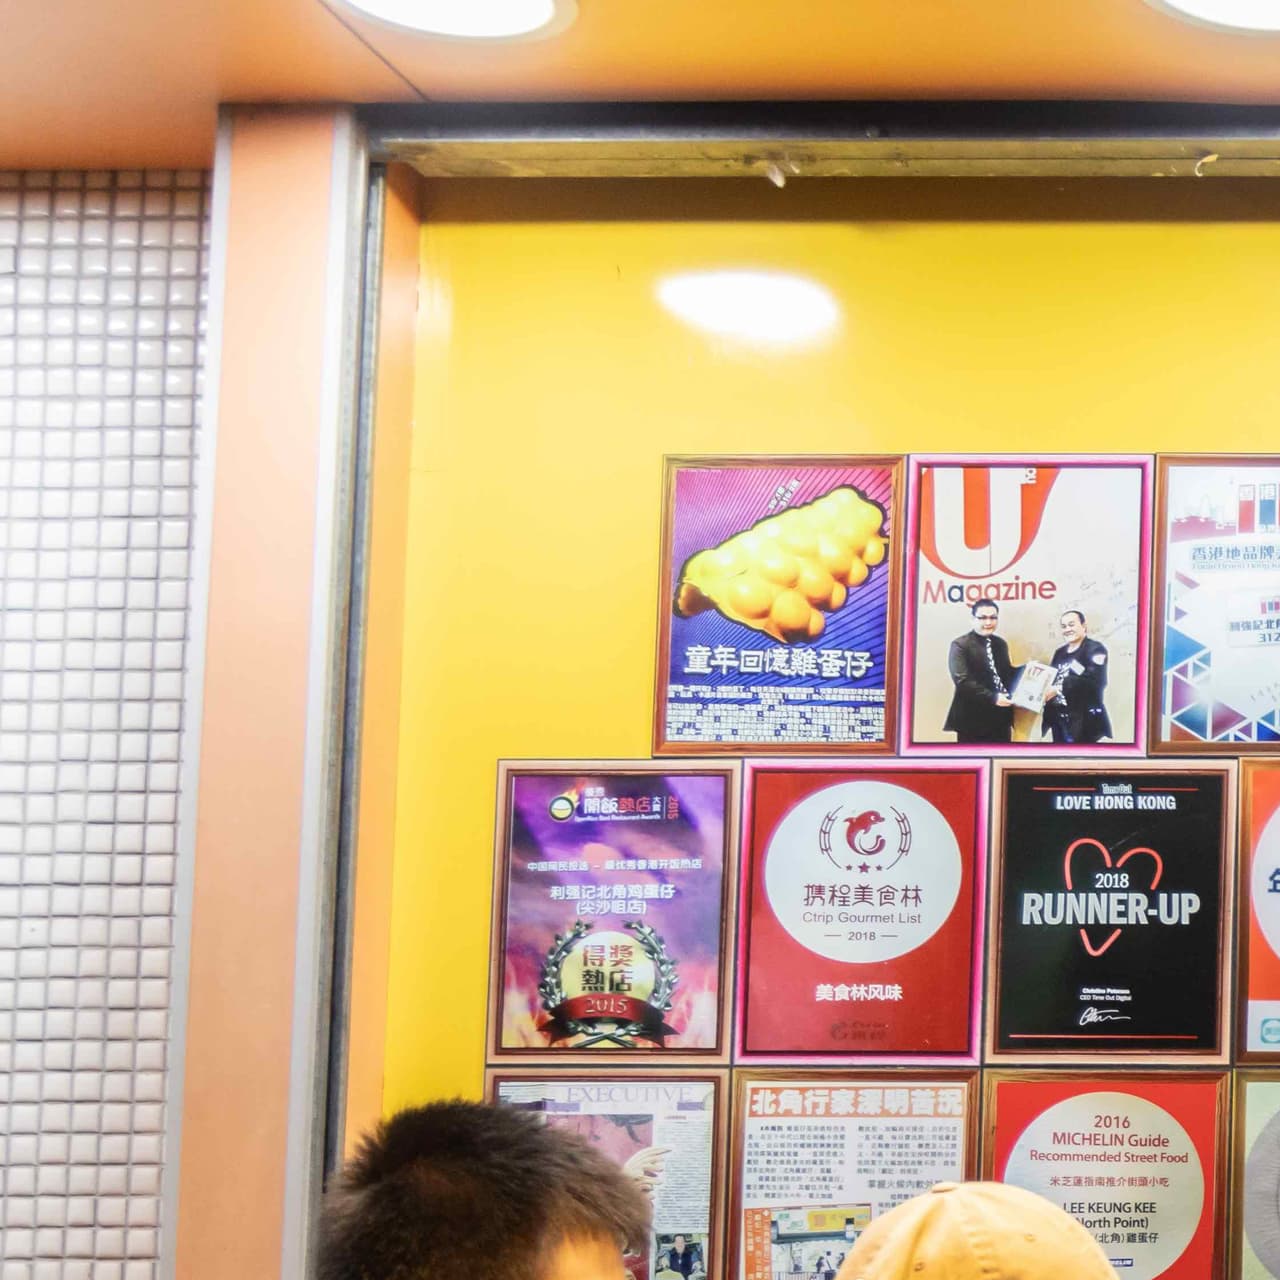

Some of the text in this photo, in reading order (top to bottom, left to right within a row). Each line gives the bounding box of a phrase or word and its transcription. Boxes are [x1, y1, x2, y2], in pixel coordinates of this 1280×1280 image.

[923, 575, 1057, 607] Magazine
[1259, 633, 1280, 643] 312
[684, 645, 873, 678] 童年回憶雞蛋仔
[1056, 796, 1177, 810] LOVE HONG KONG
[1095, 873, 1129, 888] 2018
[550, 884, 676, 901] 利强记北角鸡蛋仔
[803, 884, 922, 908] 携程美食林
[576, 899, 647, 915] (尖沙咀店)
[1022, 893, 1200, 925] RUNNER-UP
[802, 911, 921, 925] Ctrip Gourmet List
[848, 931, 876, 942] 2018
[815, 983, 903, 1002] 美食林风味
[584, 996, 629, 1014] 2015
[567, 1086, 693, 1104] EXECUTIVE
[1094, 1115, 1131, 1129] 2016
[1052, 1132, 1170, 1148] MICHELIN Guide
[1029, 1150, 1188, 1163] Recommended Street Food
[1050, 1176, 1170, 1188] 米芝蓮指南推介街頭小吃
[1064, 1202, 1157, 1214] LEE KEUNG KEE
[1113, 1217, 1149, 1230] Point)
[1126, 1233, 1159, 1244] 雞蛋仔
